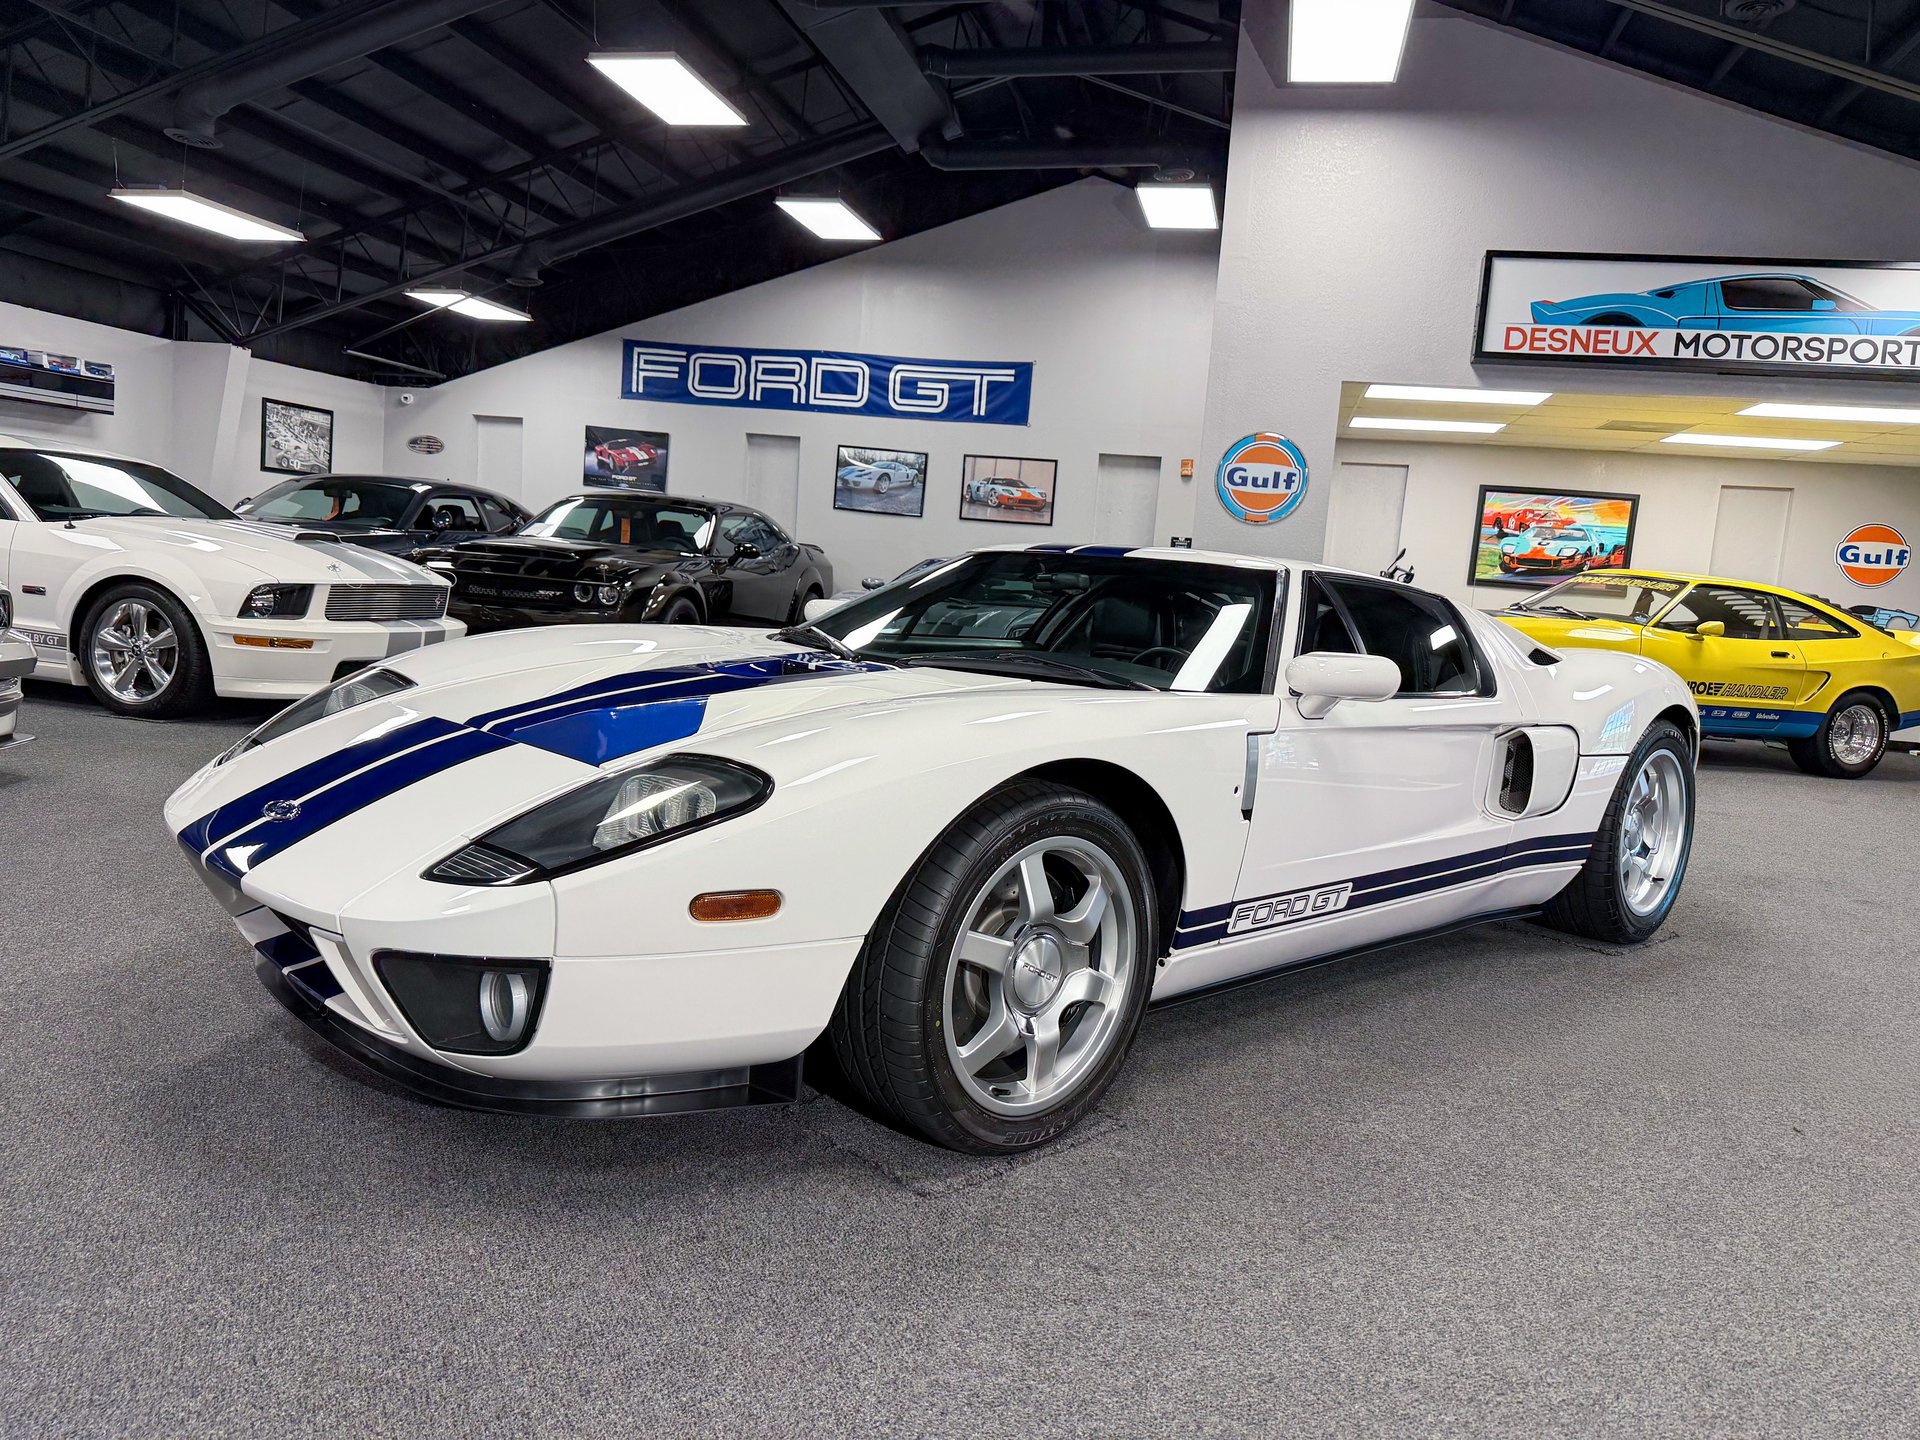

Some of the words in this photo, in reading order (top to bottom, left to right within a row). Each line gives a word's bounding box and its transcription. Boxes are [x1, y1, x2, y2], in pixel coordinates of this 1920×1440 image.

[1504, 326, 1660, 356] DESNEUX
[1674, 332, 1920, 365] MOTORSPORT
[631, 346, 870, 409] FORD
[888, 363, 1016, 417] GT
[1226, 466, 1297, 490] Gulf
[1839, 544, 1909, 566] Gulf
[46, 635, 60, 646] GT
[1720, 683, 1789, 701] HANDLER
[1231, 894, 1310, 930] FORD
[1311, 885, 1350, 912] GT
[1022, 962, 1046, 978] FORD
[1045, 972, 1058, 982] GT
